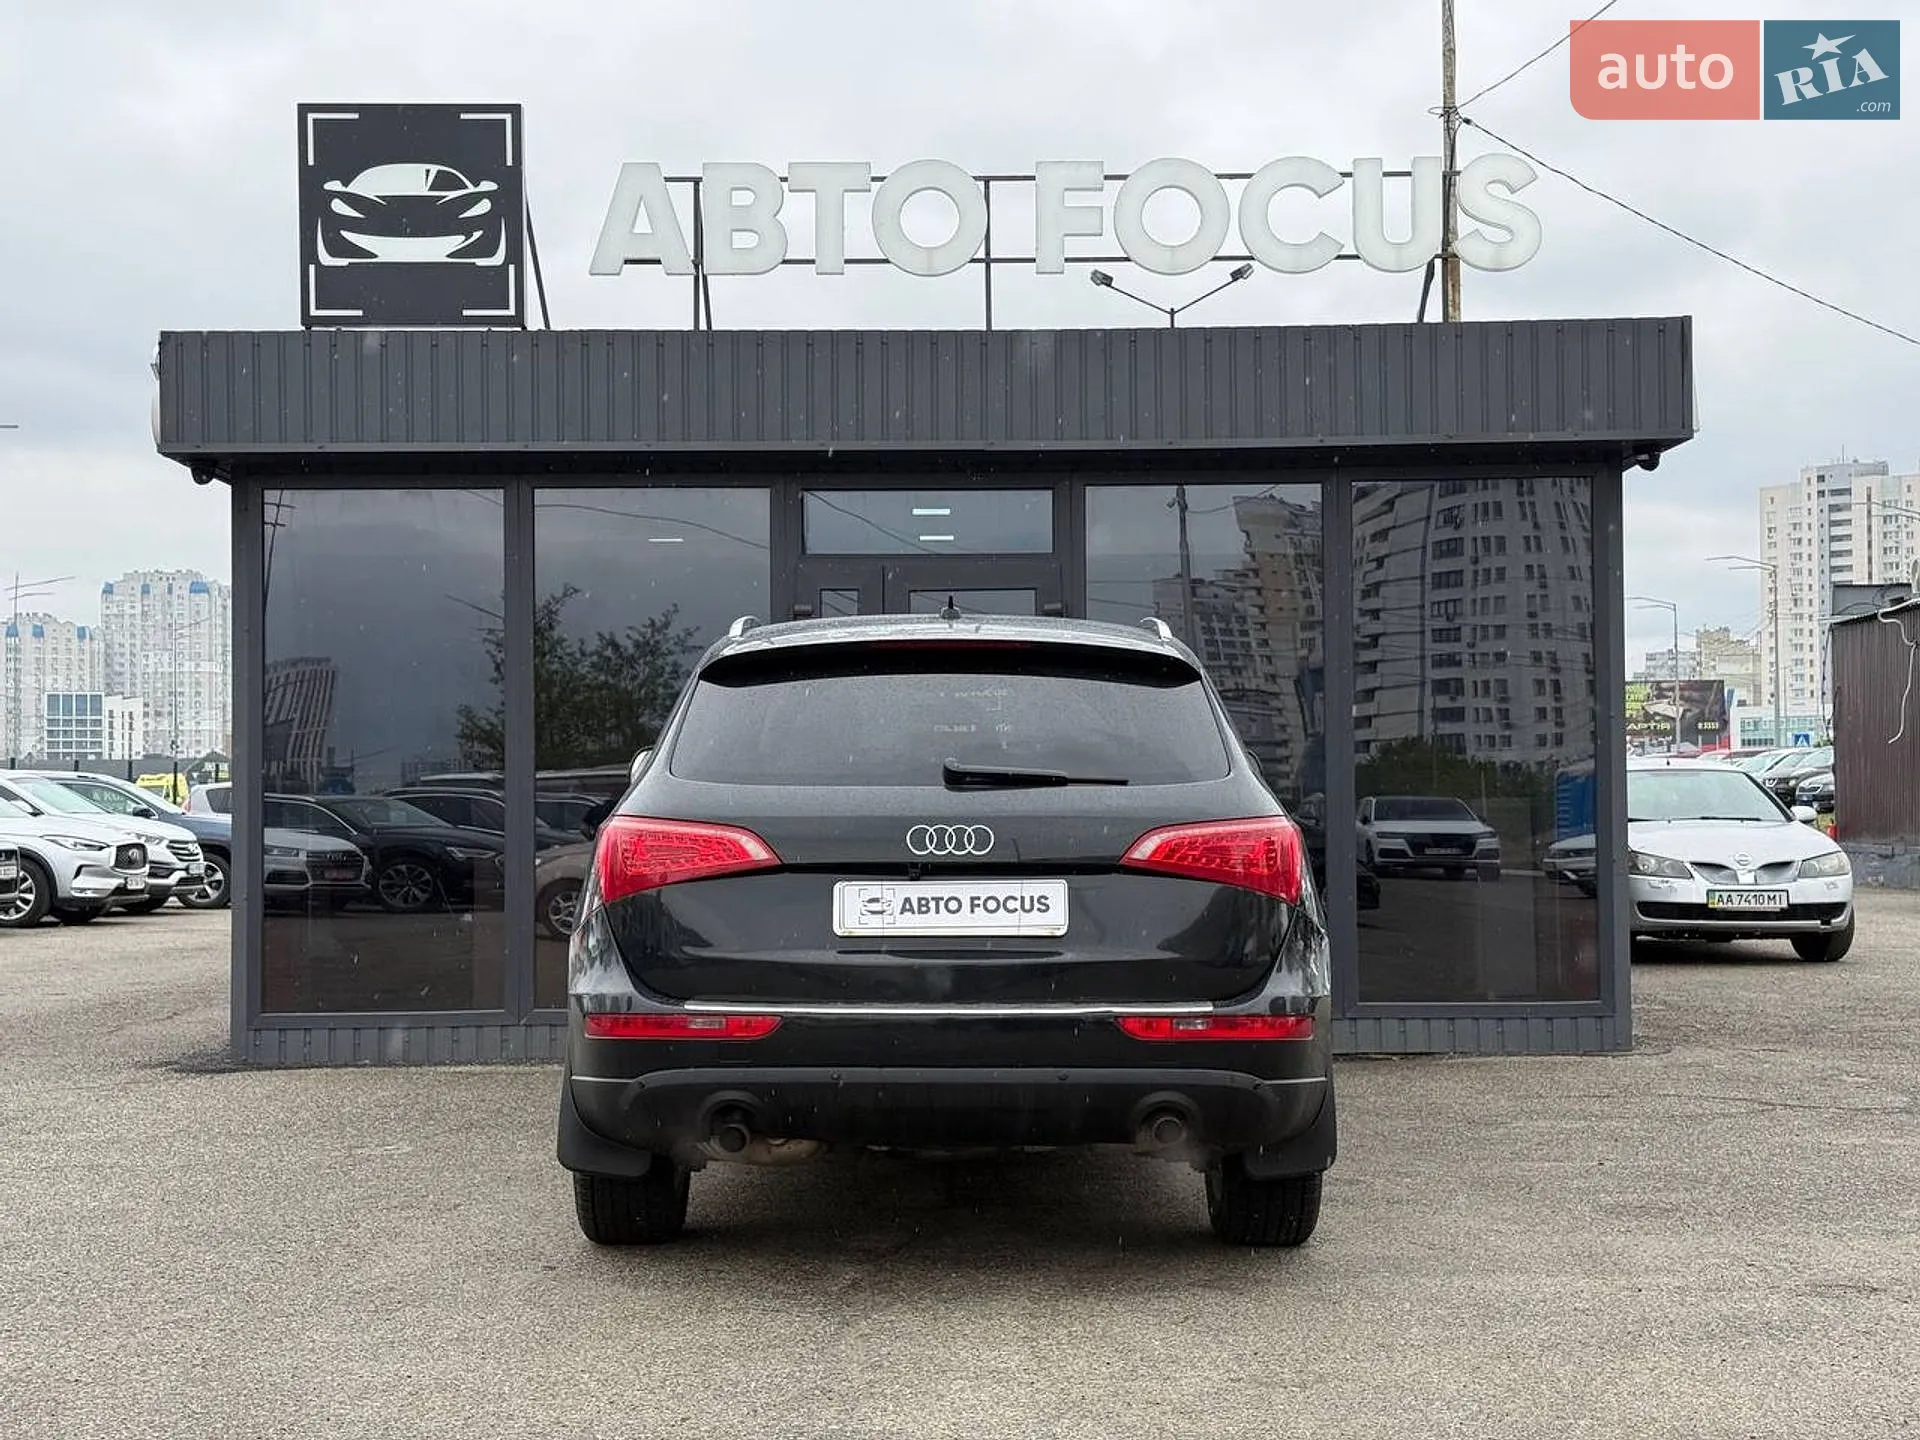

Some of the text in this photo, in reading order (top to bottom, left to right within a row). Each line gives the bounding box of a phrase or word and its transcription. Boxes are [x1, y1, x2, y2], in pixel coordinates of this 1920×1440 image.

[589, 153, 1542, 276] АВТО FOCUS
[900, 895, 1050, 915] АВТО FOCUS
